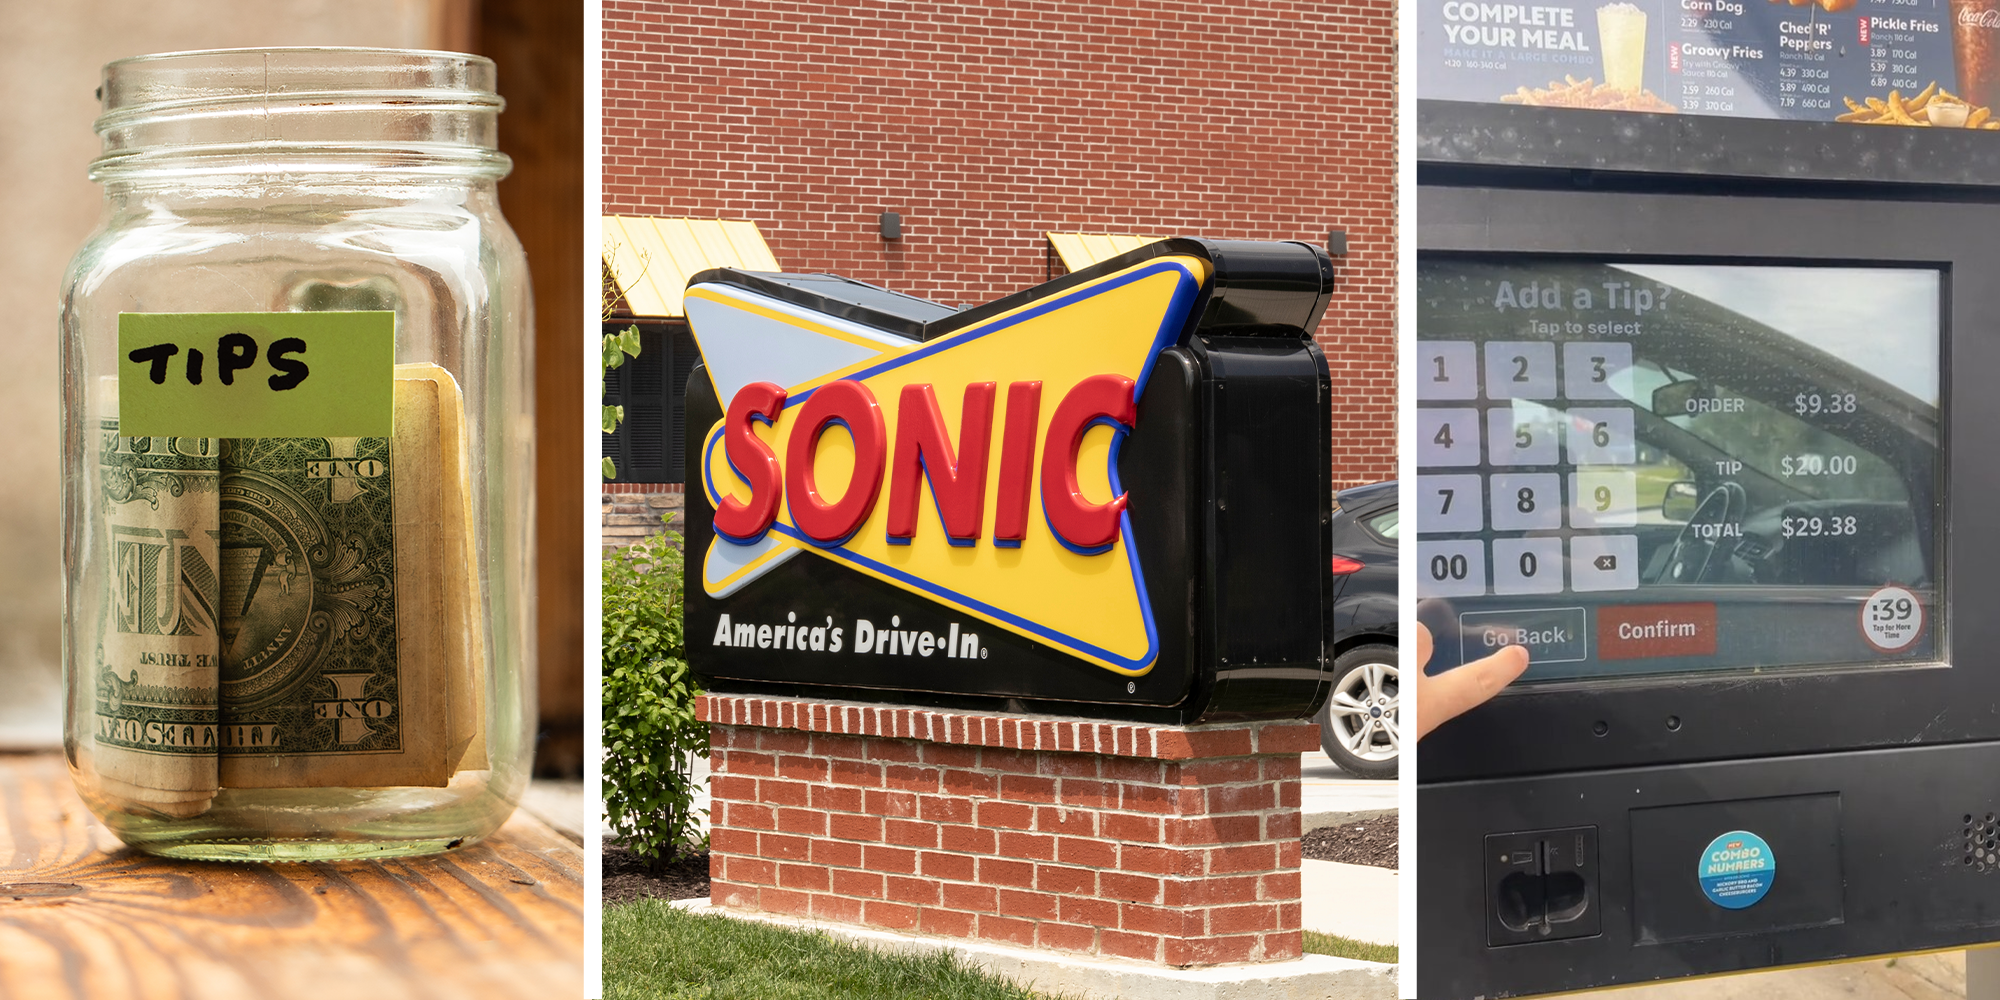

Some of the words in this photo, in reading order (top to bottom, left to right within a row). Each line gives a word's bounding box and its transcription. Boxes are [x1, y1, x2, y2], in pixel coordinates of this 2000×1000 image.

[1443, 1, 1575, 27] COMPLETE
[1681, 0, 1713, 11] Corn
[1681, 17, 1698, 27] 2.29
[1704, 18, 1718, 29] 230
[1720, 19, 1732, 30] Cal
[1860, 19, 1868, 41] NEW
[1871, 17, 1908, 30] Pickle
[1910, 20, 1939, 33] Fries
[1443, 24, 1516, 47] YOUR
[1522, 29, 1590, 51] MEAL
[1871, 32, 1893, 41] Ranch
[1904, 34, 1914, 42] Cal
[1444, 48, 1478, 58] MAKE
[1482, 50, 1493, 58] IT
[1499, 51, 1506, 59] A
[1511, 52, 1547, 62] LARGE
[1552, 54, 1594, 64] COMBO
[1670, 45, 1678, 69] NEW
[1682, 43, 1729, 60] Groovy
[1733, 45, 1763, 59] Fries
[1780, 52, 1803, 60] Ranch
[1814, 53, 1825, 61] Cal
[1870, 48, 1886, 57] 3.89
[1892, 49, 1904, 59] 170
[1904, 50, 1917, 59] Cal
[1495, 62, 1507, 70] Cal
[1780, 68, 1796, 77] 4.39
[1801, 69, 1815, 78] 330
[1816, 69, 1829, 79] Cal
[1870, 63, 1886, 72] 5.39
[1892, 64, 1904, 73] 310
[1904, 65, 1917, 74] Cal
[1682, 85, 1699, 95] 2.59
[1705, 86, 1720, 96] 260
[1721, 87, 1734, 96] Cal
[1780, 82, 1796, 92] 5.89
[1802, 83, 1816, 93] 490
[1817, 84, 1830, 94] Cal
[1870, 77, 1887, 87] 6.89
[1892, 79, 1904, 88] 410
[1905, 79, 1917, 89] Cal
[1682, 100, 1699, 110] 3.39
[1705, 101, 1720, 111] 370
[1721, 101, 1733, 111] Cal
[1780, 98, 1795, 107] 7.19
[1802, 99, 1817, 108] 660
[1818, 99, 1831, 109] Cal
[1495, 280, 1563, 309] Add
[1573, 287, 1592, 309] a
[1603, 281, 1672, 316] Tip?
[1529, 319, 1560, 340] Tap
[1565, 320, 1583, 334] to
[1588, 321, 1641, 335] select
[128, 332, 310, 392] TIPS
[1433, 356, 1449, 382] 1
[1512, 356, 1529, 382] 2
[1590, 356, 1606, 382] 3
[1685, 398, 1745, 413] ORDER
[1794, 393, 1857, 416] $9.38
[1433, 423, 1453, 448] 4
[1515, 423, 1532, 448] 5
[1592, 421, 1609, 447] 6
[305, 457, 385, 479] ONE
[713, 373, 1137, 557] SONIC
[1716, 461, 1742, 475] TIP
[1781, 454, 1857, 478] $20.00
[1437, 489, 1454, 515] 7
[1517, 487, 1535, 513] 8
[1594, 486, 1611, 511] 9
[1691, 522, 1744, 538] TOTAL
[1781, 516, 1857, 539] $29.38
[1430, 554, 1468, 581] 00
[1519, 552, 1537, 577] 0
[1872, 598, 1912, 621] :39
[712, 611, 844, 654] America's
[1483, 630, 1509, 647] Go
[1515, 627, 1565, 645] Back
[1618, 620, 1696, 640] Confirm
[1873, 624, 1884, 632] Tap
[139, 650, 191, 667] TRUST
[312, 700, 393, 720] ONE
[1712, 847, 1760, 861] COMBO
[1708, 858, 1764, 873] NUMBERS
